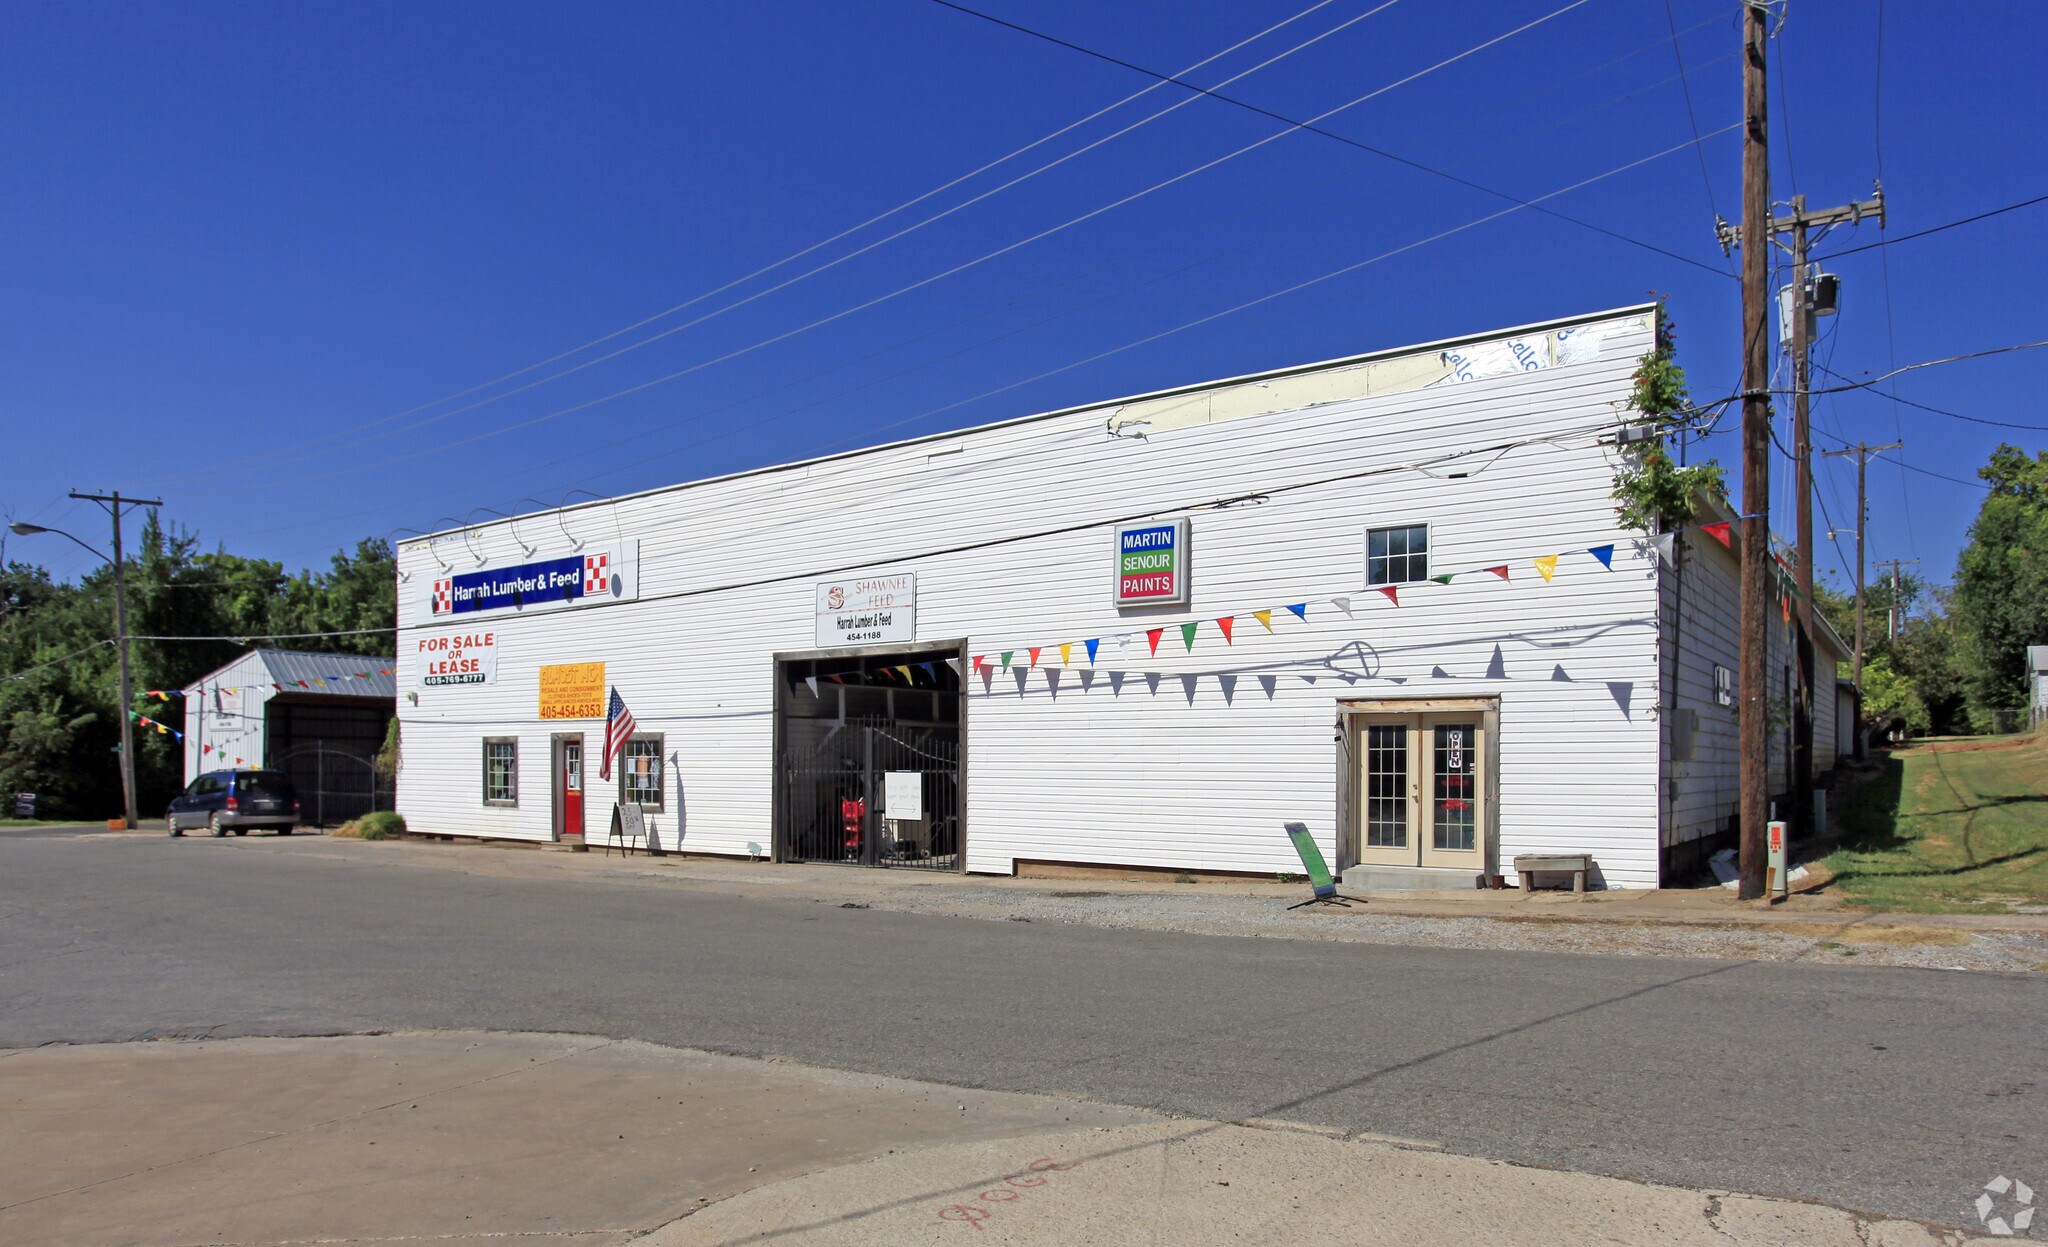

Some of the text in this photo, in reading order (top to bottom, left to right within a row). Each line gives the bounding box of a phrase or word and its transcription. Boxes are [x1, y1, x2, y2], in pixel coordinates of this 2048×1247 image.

[1124, 531, 1171, 548] MARTIN
[1124, 554, 1170, 571] SENOUR
[454, 568, 580, 601] Harrah Lumber & Feed
[856, 577, 907, 594] SHAWNEE
[1123, 576, 1170, 593] PAINTS
[869, 593, 894, 607] FEED
[837, 615, 854, 629] Harrah
[855, 614, 873, 628] Lumber
[879, 611, 892, 626] Feed
[419, 633, 494, 652] FOR SALE
[846, 631, 881, 640] 454-1188
[448, 650, 462, 659] OR
[429, 659, 479, 675] LEASE
[541, 704, 601, 718] 405-454-6353
[1451, 732, 1460, 766] OPEN
